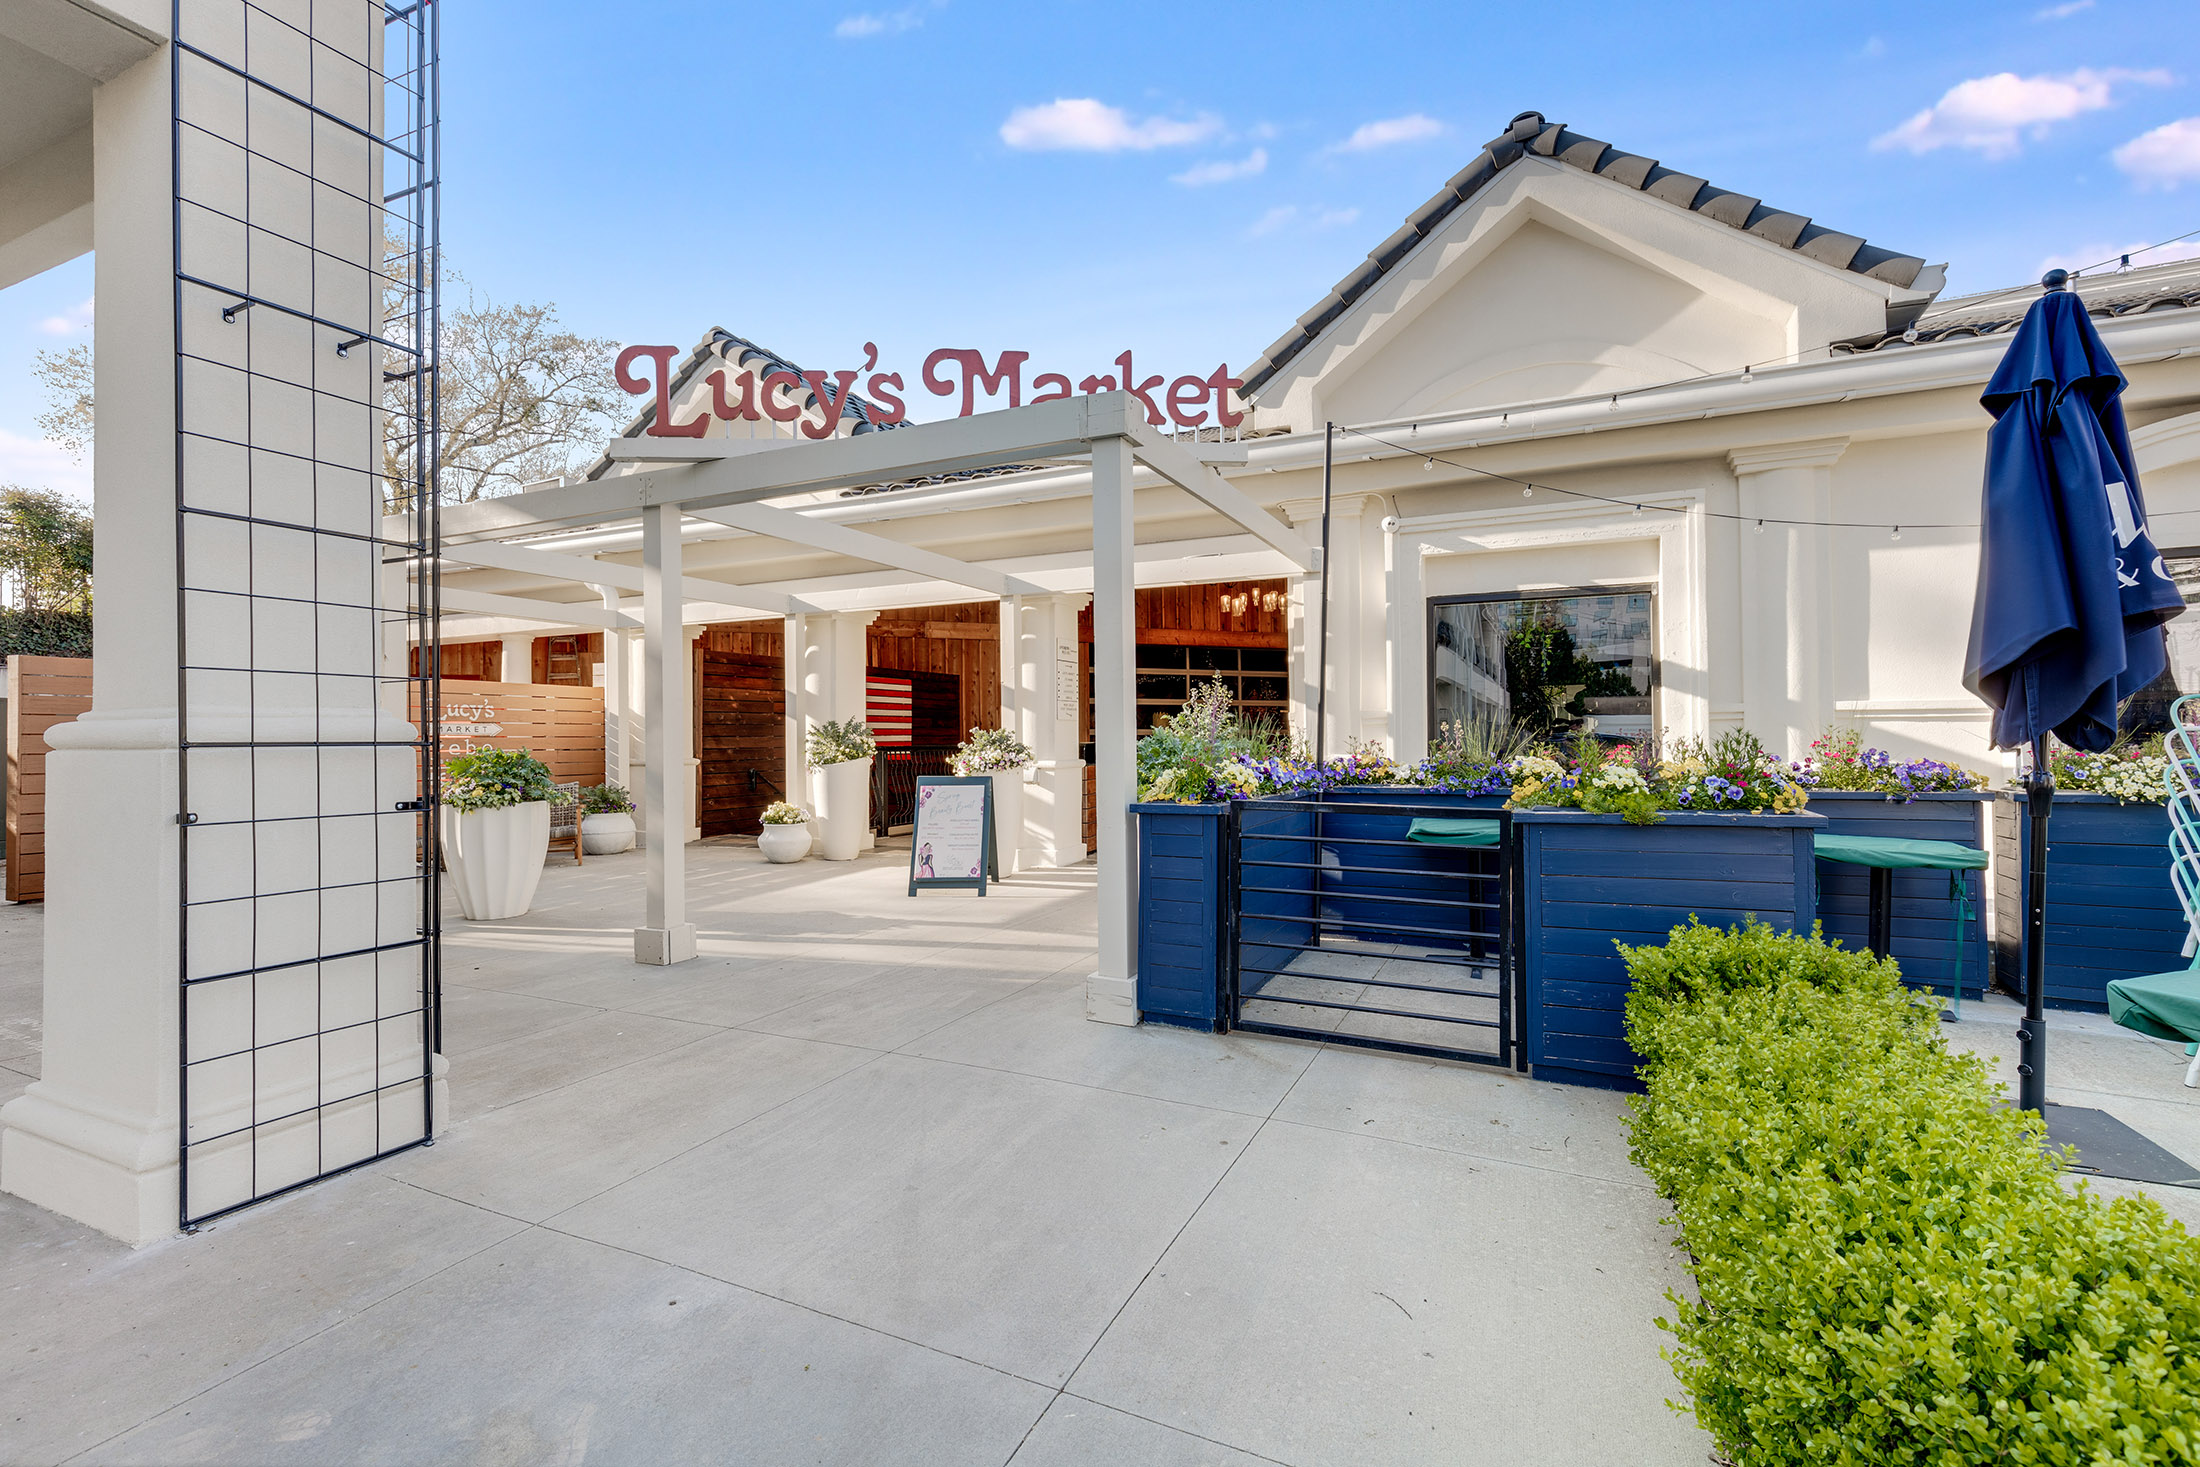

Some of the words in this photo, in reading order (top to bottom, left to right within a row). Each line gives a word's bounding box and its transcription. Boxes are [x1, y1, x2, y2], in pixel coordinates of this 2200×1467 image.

[614, 341, 906, 439] Lucy's
[430, 698, 495, 721] ucy's
[439, 739, 493, 755] ebo
